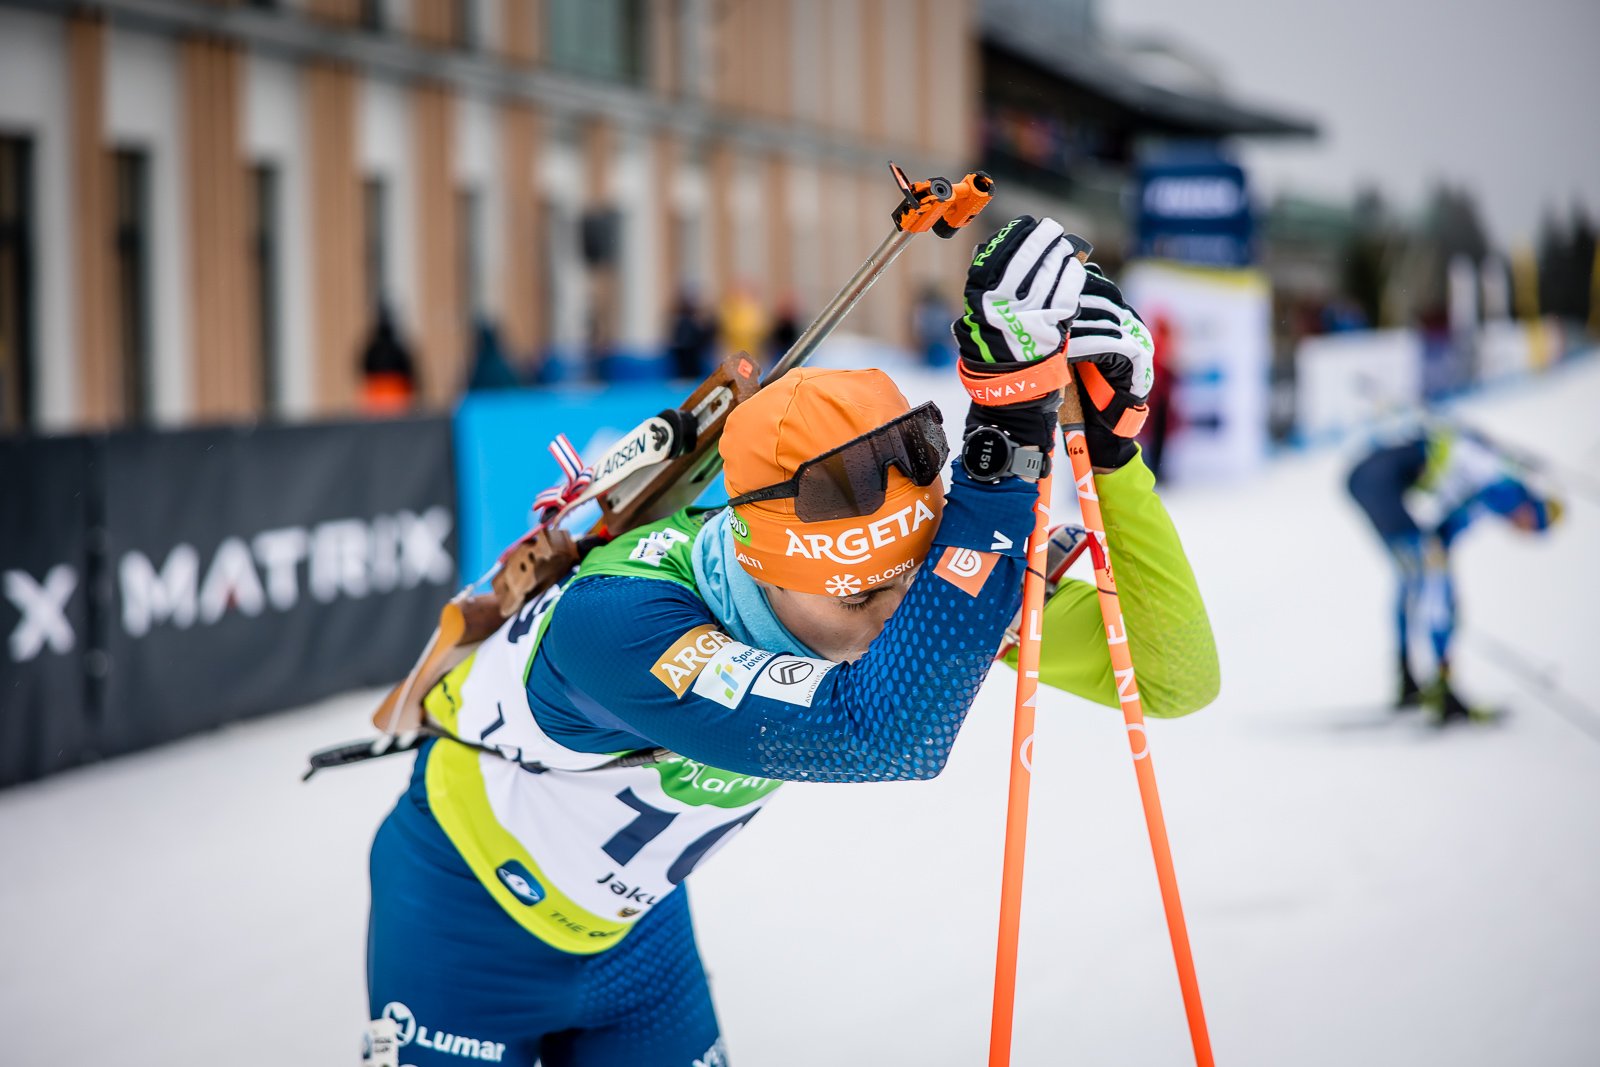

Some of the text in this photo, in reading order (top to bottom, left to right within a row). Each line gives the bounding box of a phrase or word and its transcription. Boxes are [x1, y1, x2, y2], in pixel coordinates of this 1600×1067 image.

[592, 434, 647, 483] LARSEN
[785, 498, 936, 565] ARGETA
[118, 504, 454, 638] MATRIX
[734, 547, 764, 570] ALTI
[867, 558, 916, 586] SLOSKI
[415, 1025, 506, 1062] Lumar
